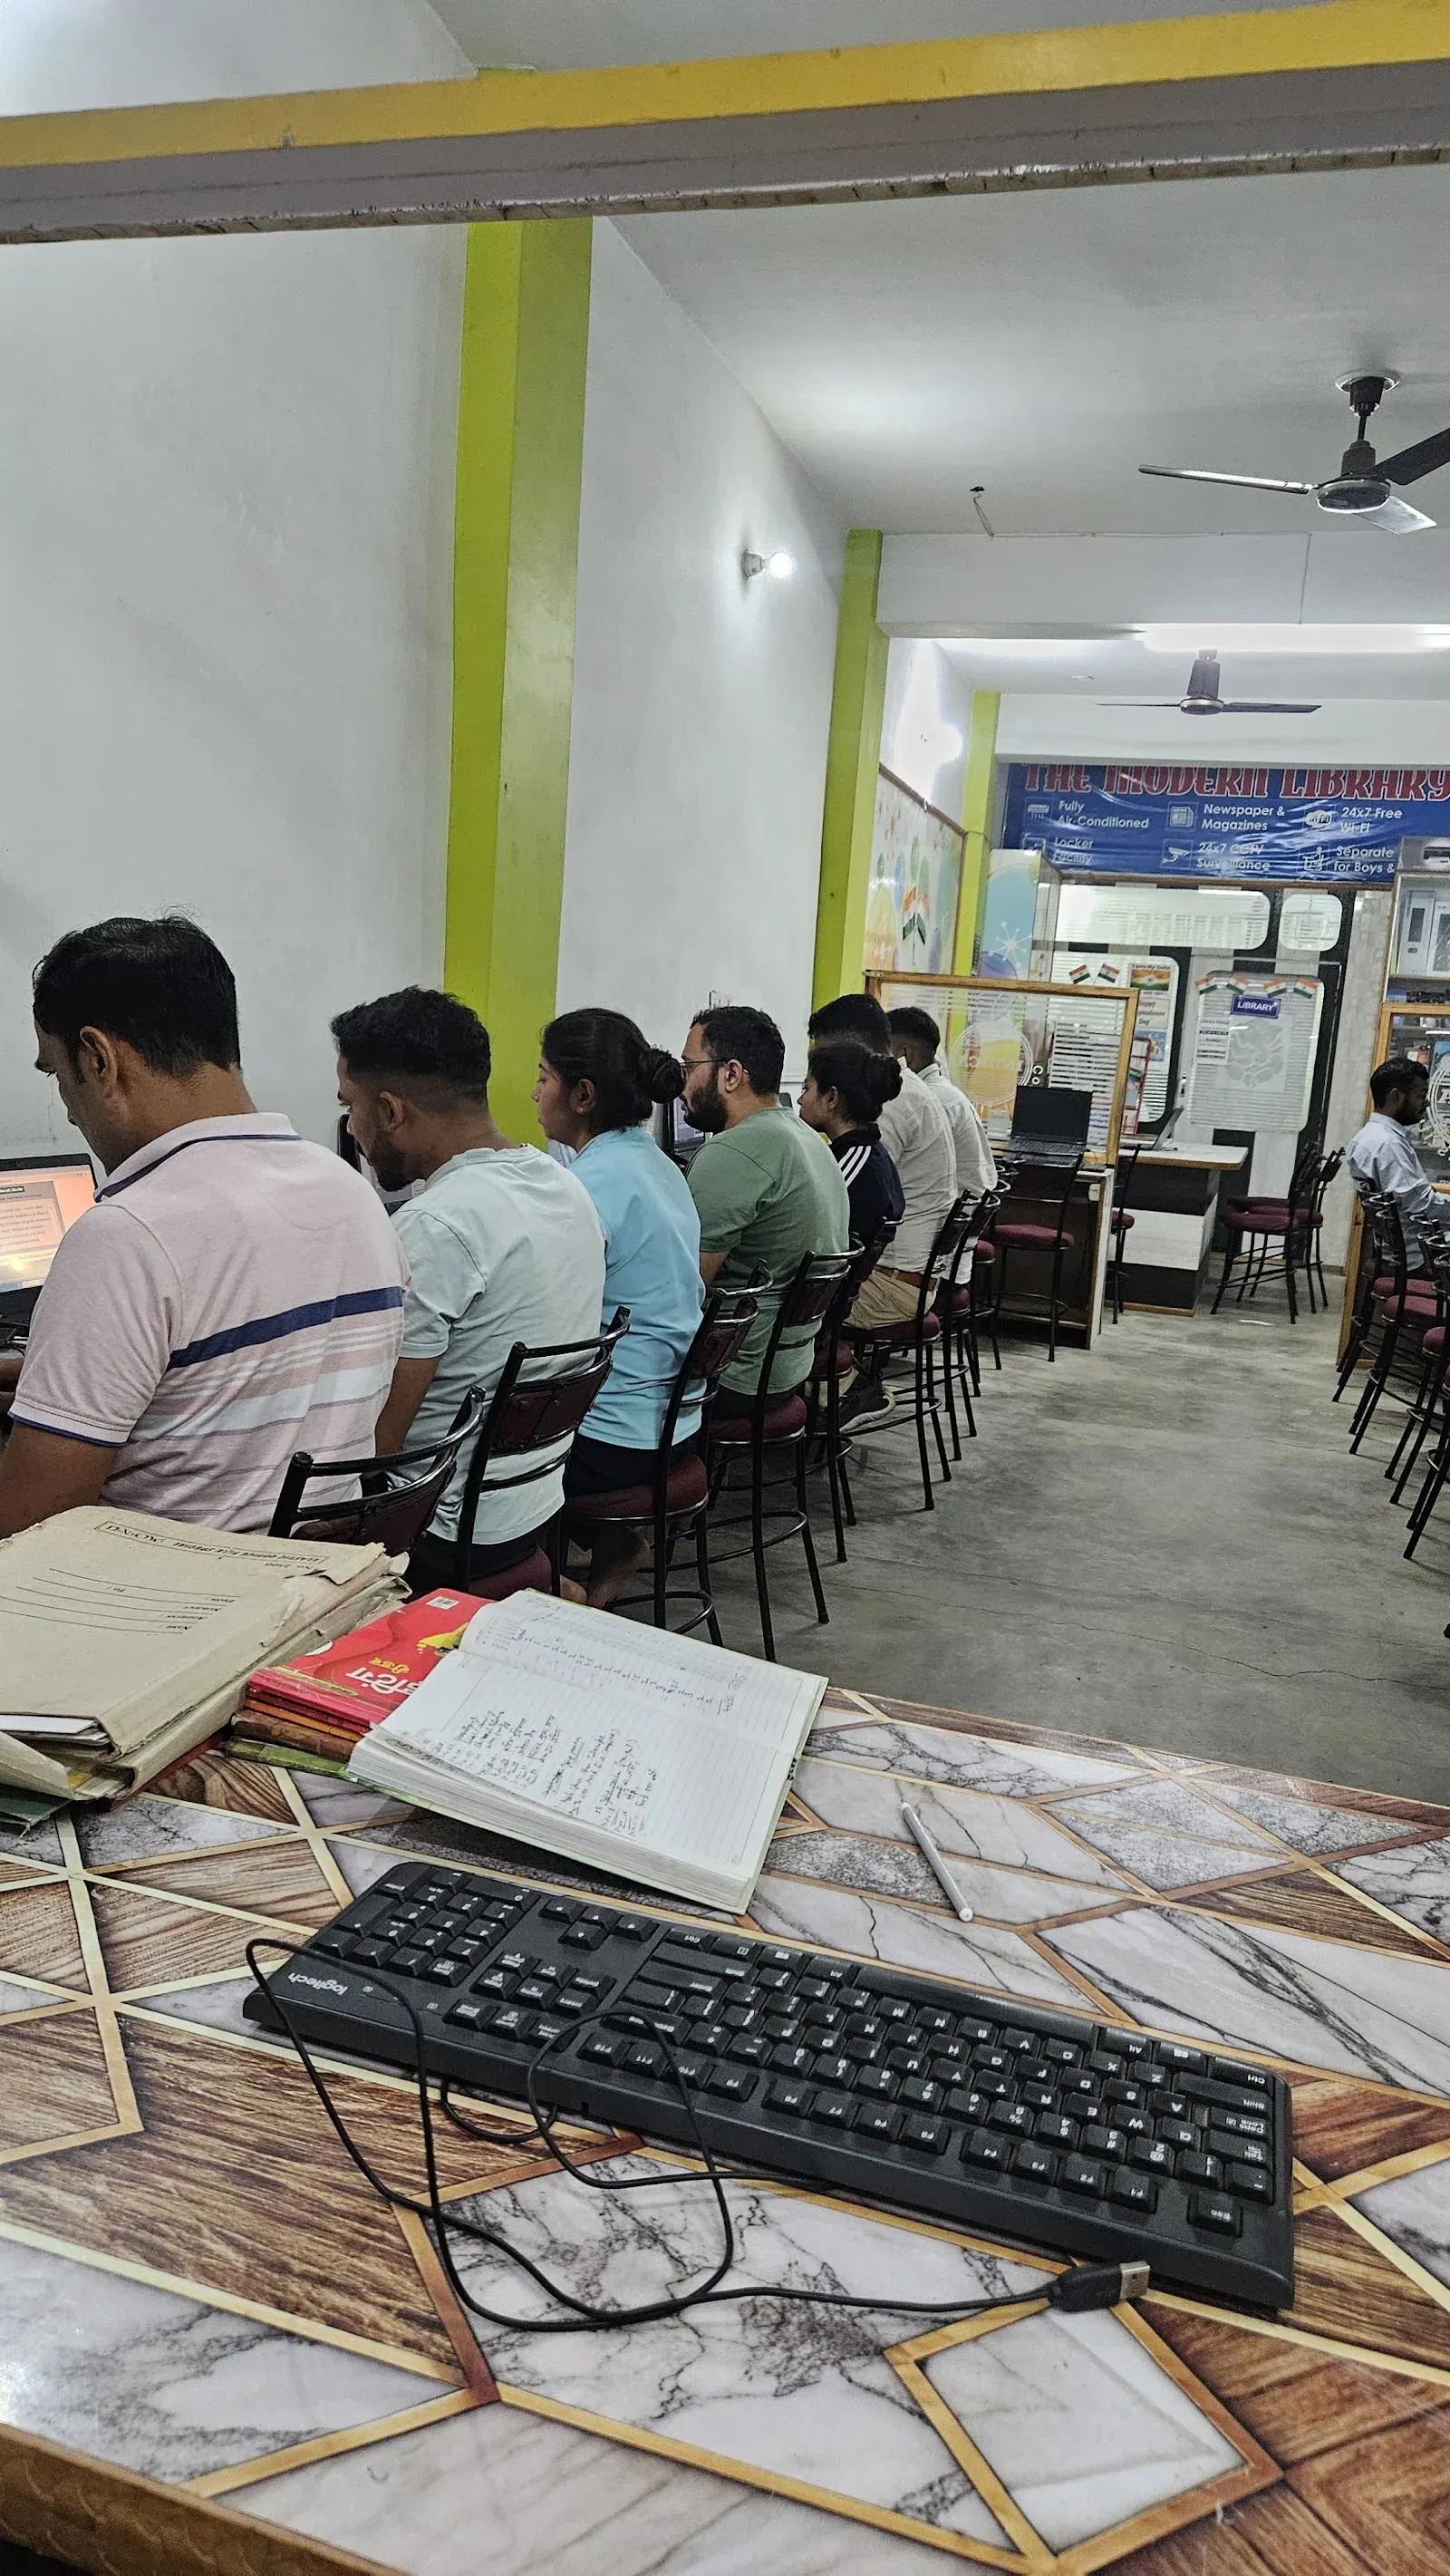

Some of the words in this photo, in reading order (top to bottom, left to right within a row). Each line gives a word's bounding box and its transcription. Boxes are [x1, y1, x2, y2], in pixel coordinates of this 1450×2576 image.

[1058, 800, 1085, 813] Fully
[1204, 804, 1274, 817] Newspaper
[1276, 805, 1285, 816] &
[1341, 807, 1371, 818] 24x7
[1375, 808, 1403, 819] Free
[1058, 815, 1149, 828] Air-Conditioned
[1202, 818, 1268, 831] Magazines
[1340, 822, 1370, 833] Wi-Fi
[1054, 837, 1094, 849] Locker
[1198, 842, 1227, 853] 24x7
[1230, 843, 1264, 855] CCTV
[1336, 846, 1394, 860] Separate
[1197, 857, 1271, 871] Surveillance
[1333, 861, 1350, 872] for
[1354, 861, 1383, 875] Boys
[1387, 862, 1395, 873] &
[1237, 1001, 1275, 1012] LIBRARY
[288, 1973, 349, 1996] logitech
[1129, 2045, 1143, 2054] Alt
[1248, 2075, 1266, 2085] Ctrl
[1243, 2099, 1265, 2110] Shift
[1080, 2174, 1094, 2184] F2
[1131, 2189, 1144, 2198] F1
[1212, 2210, 1231, 2223] Esc
